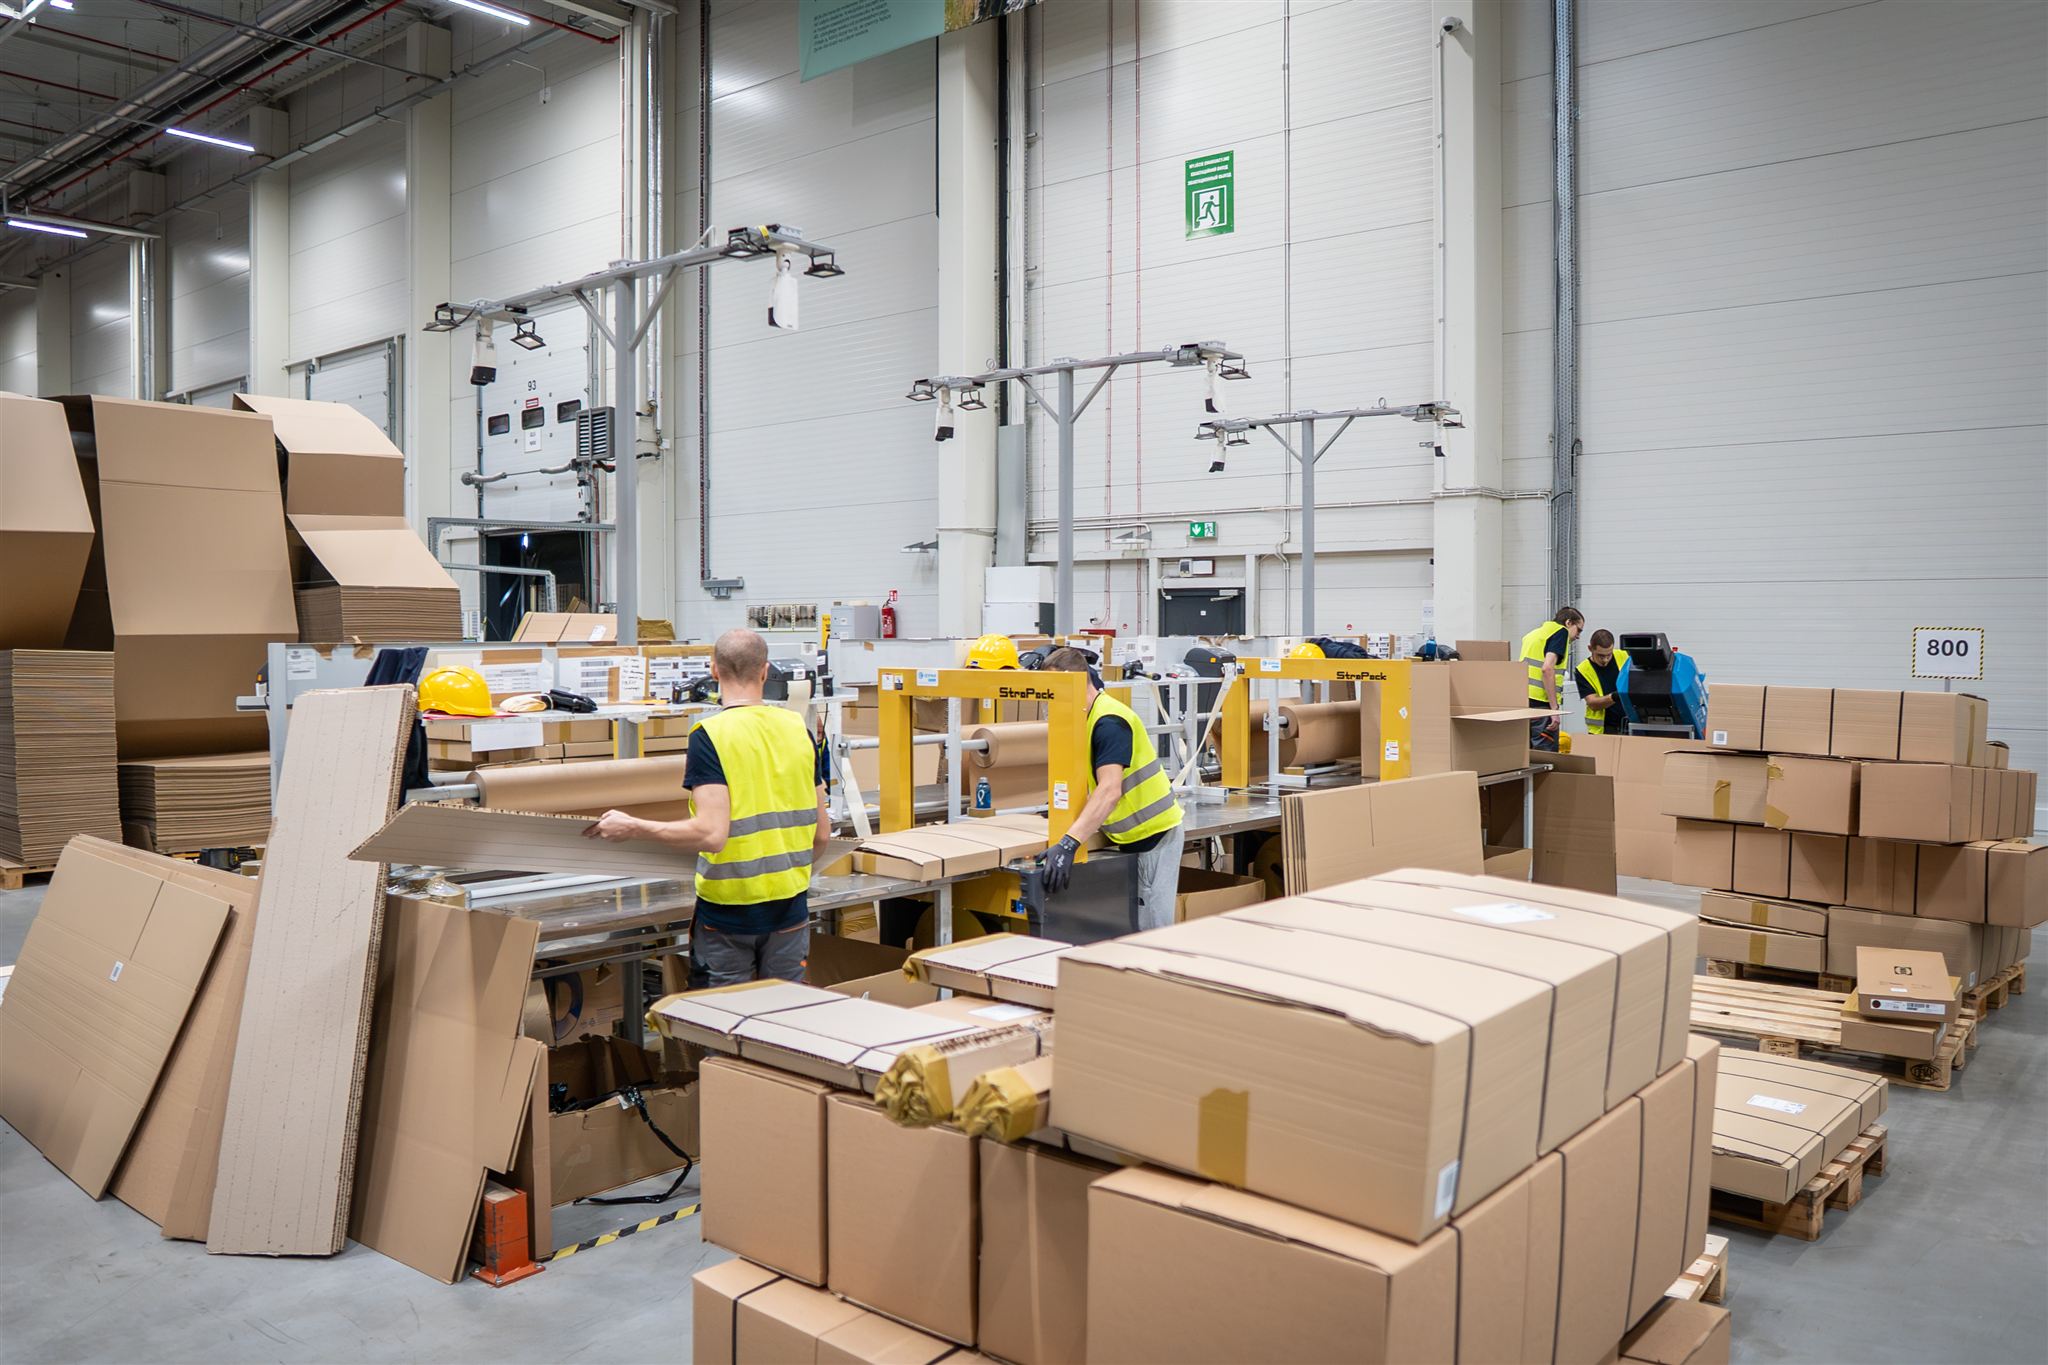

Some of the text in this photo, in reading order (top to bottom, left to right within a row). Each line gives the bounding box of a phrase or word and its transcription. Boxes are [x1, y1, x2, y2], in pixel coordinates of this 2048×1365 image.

[528, 380, 536, 391] 93
[1927, 639, 1969, 657] 800
[1336, 671, 1387, 681] StraPack
[999, 687, 1055, 700] StraPack
